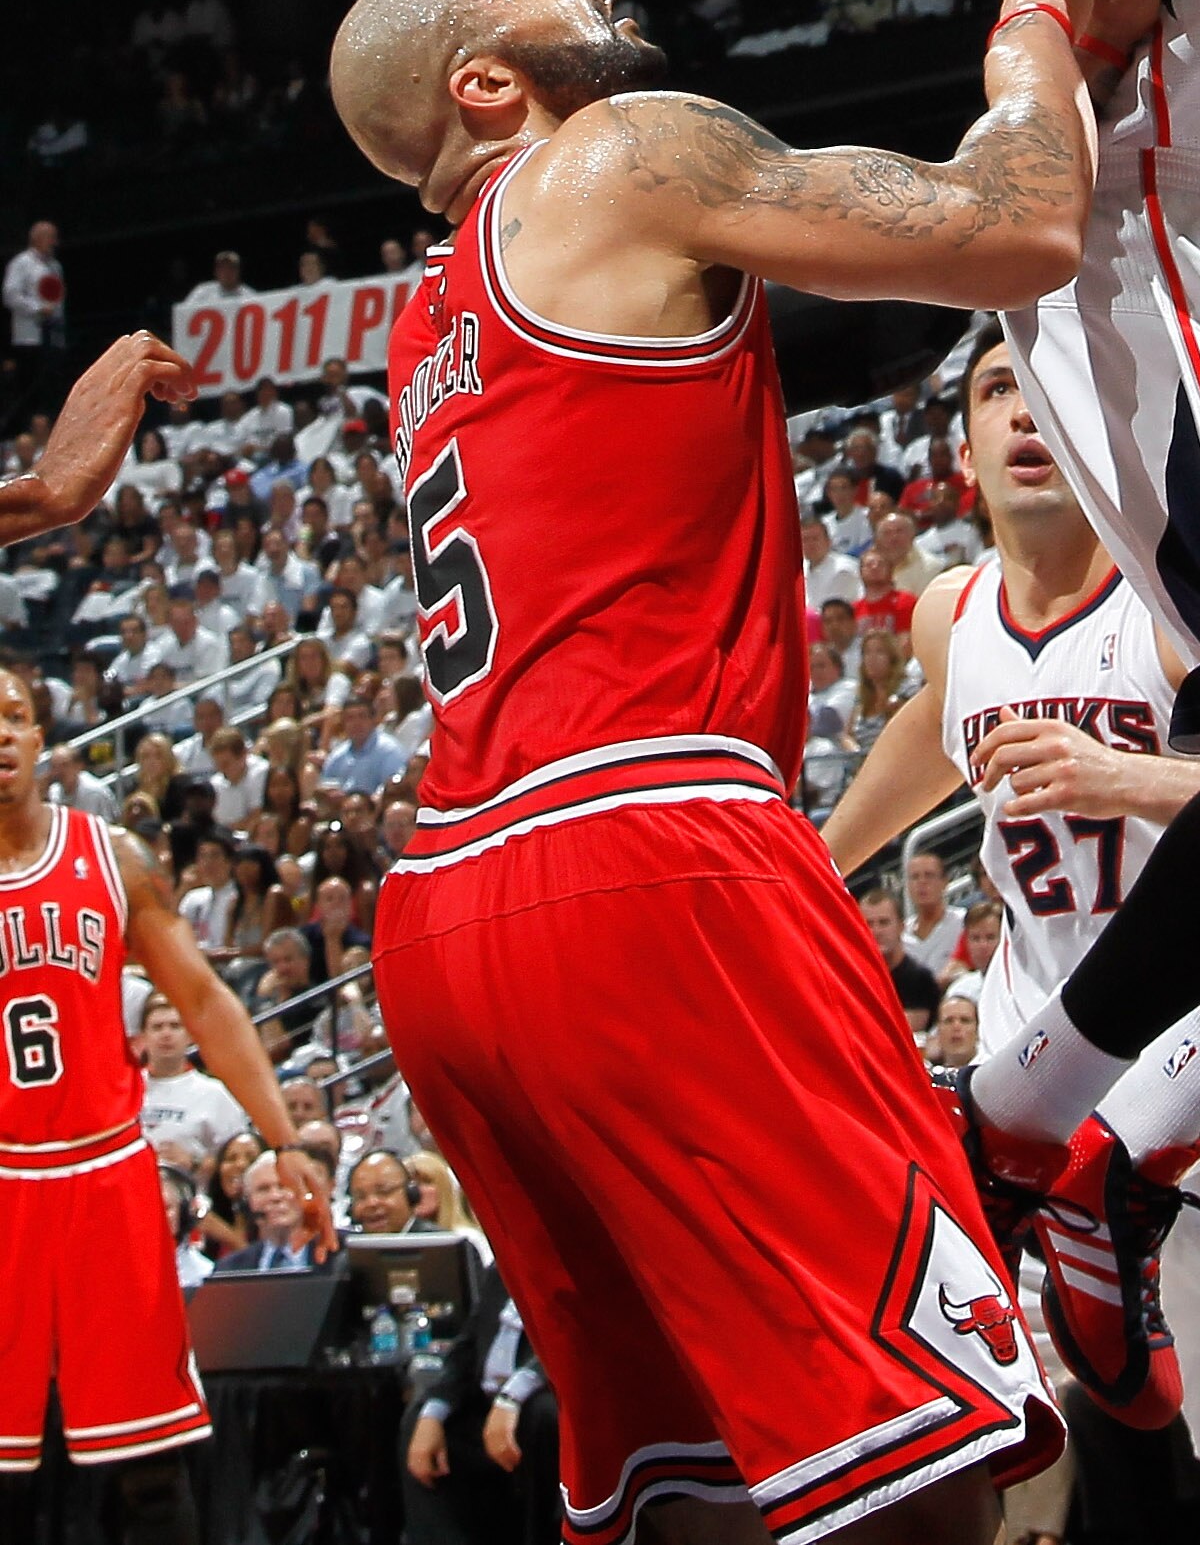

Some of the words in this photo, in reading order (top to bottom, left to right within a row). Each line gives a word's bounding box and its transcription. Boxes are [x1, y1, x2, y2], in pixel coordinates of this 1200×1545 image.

[187, 294, 330, 387] 2011
[406, 436, 499, 706] 5
[997, 815, 1126, 917] 27
[3, 993, 63, 1089] 6
